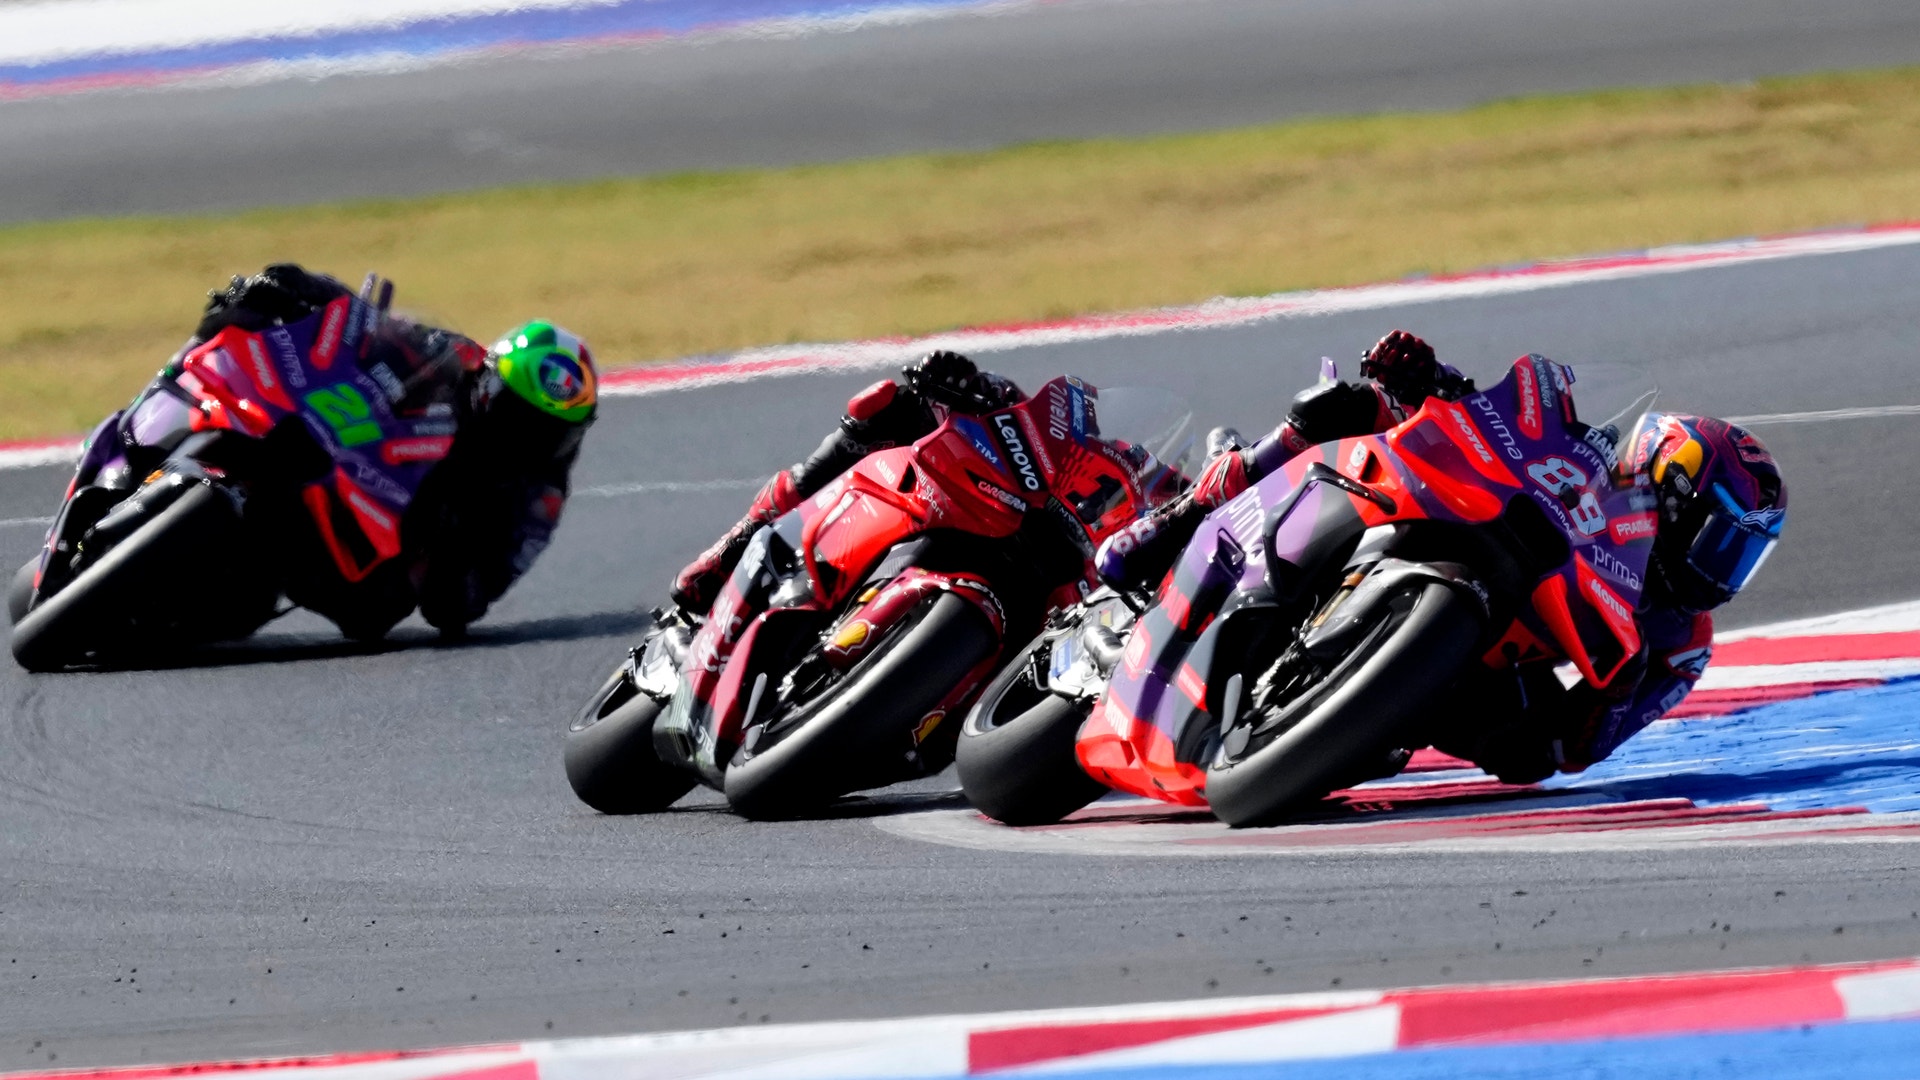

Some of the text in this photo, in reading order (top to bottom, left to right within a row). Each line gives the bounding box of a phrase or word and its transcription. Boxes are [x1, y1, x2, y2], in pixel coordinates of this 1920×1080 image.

[303, 382, 384, 448] 21
[1519, 364, 1538, 428] PRAMAC
[974, 438, 999, 464] TIM
[994, 413, 1040, 491] Lenovo
[1449, 407, 1494, 464] MOTUL
[1471, 393, 1524, 460] prima
[977, 480, 1028, 512] CARRERA
[1526, 457, 1607, 536] 89
[1533, 489, 1576, 541] PRAMAC
[1592, 544, 1640, 591] prima
[1591, 578, 1630, 622] MOTUL
